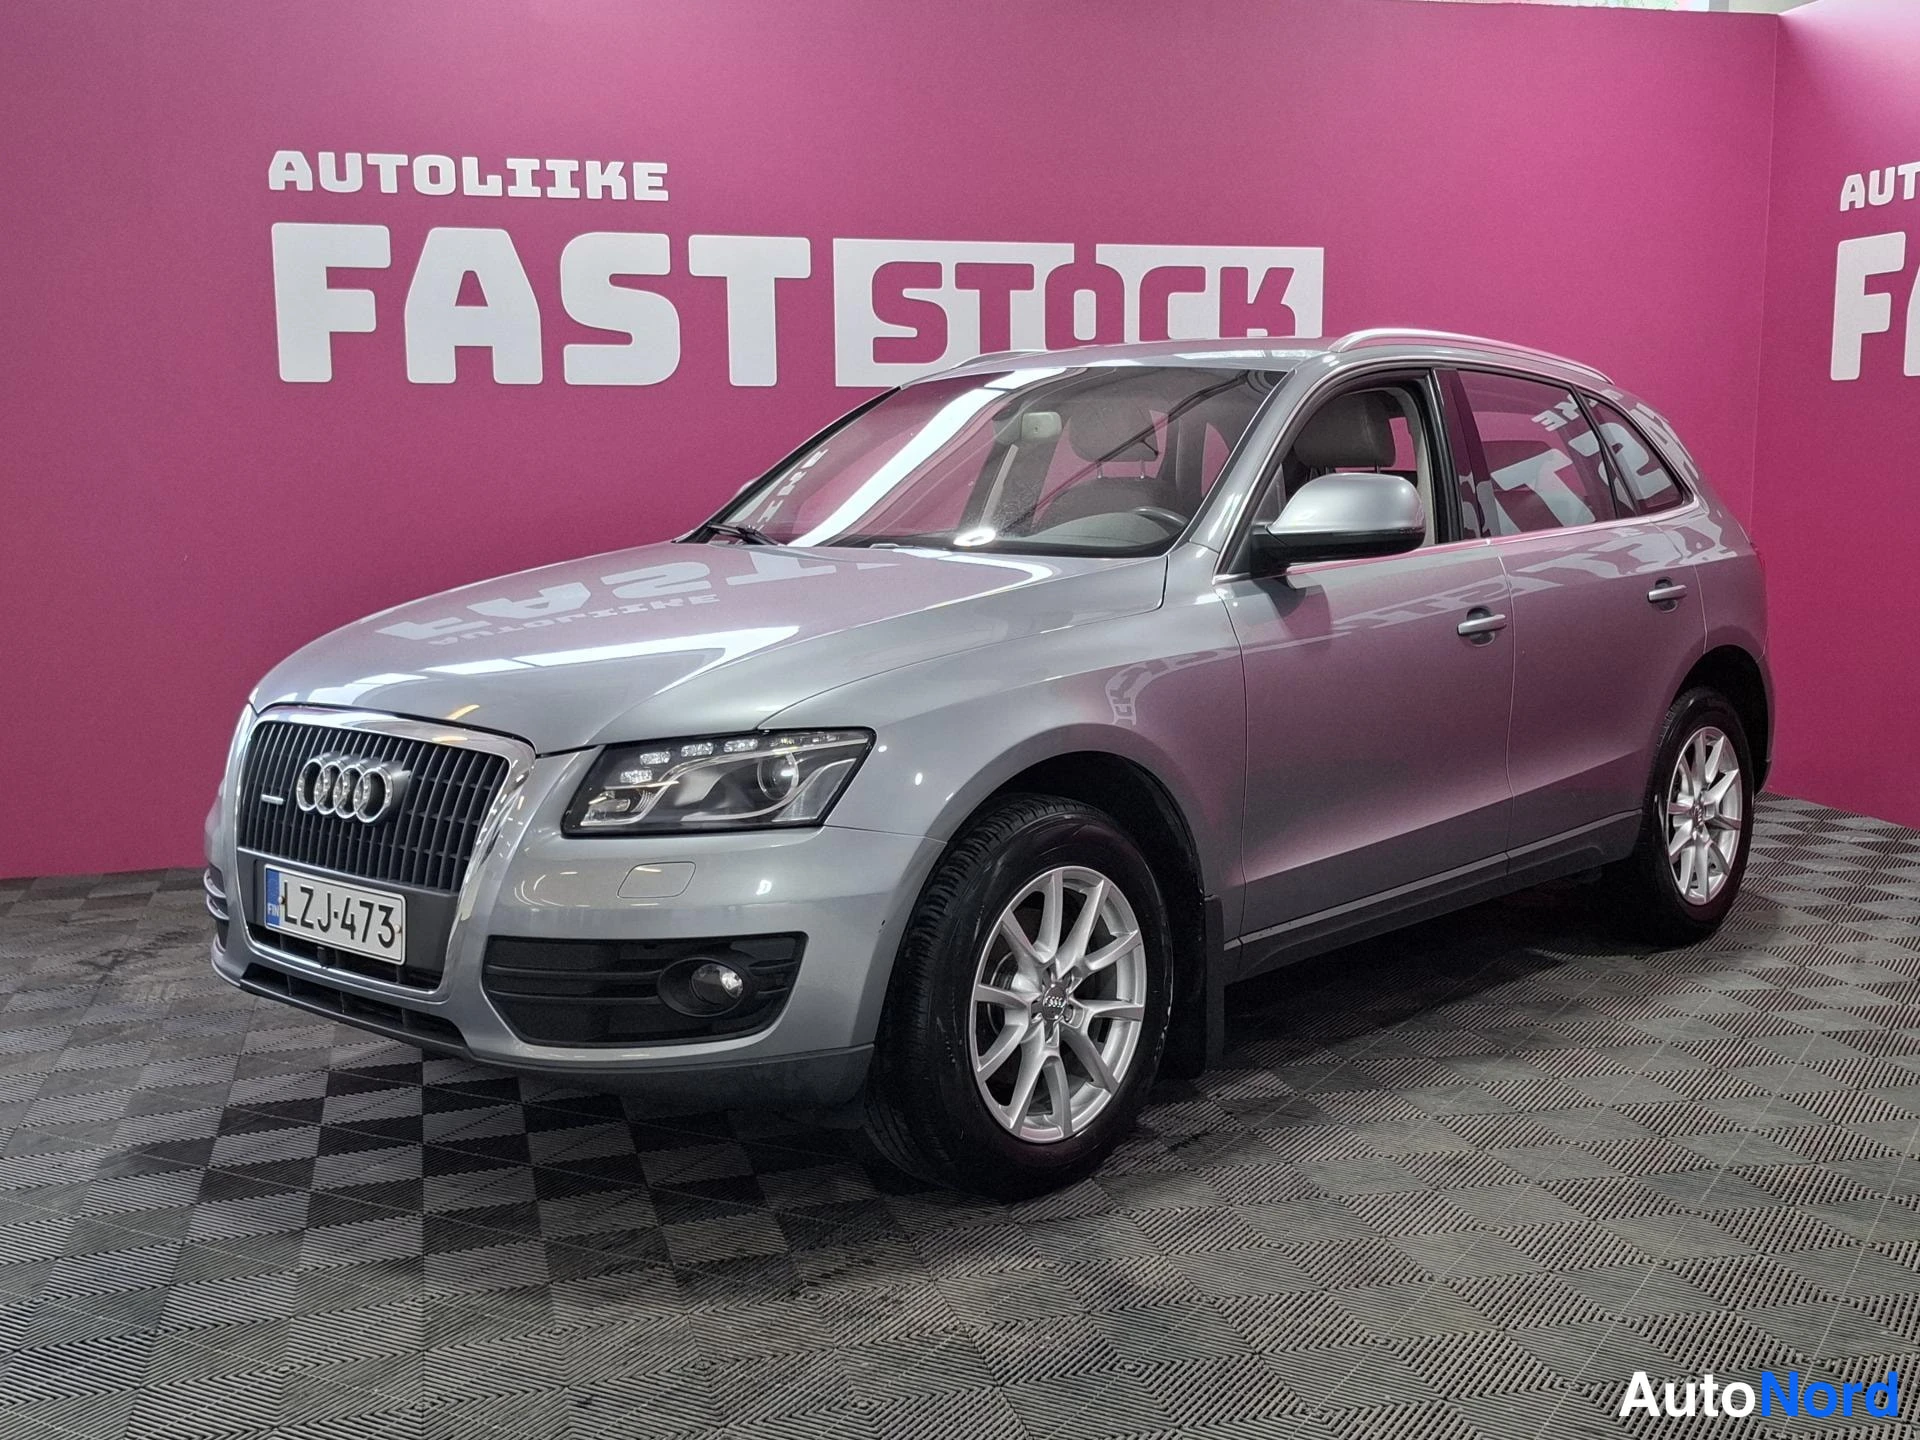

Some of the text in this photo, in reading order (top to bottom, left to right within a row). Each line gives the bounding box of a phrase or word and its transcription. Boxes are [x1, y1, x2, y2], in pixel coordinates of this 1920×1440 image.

[268, 150, 669, 201] AUTOLIIKE
[271, 222, 1297, 387] FAST STOCK
[283, 881, 396, 949] LZJ-473
